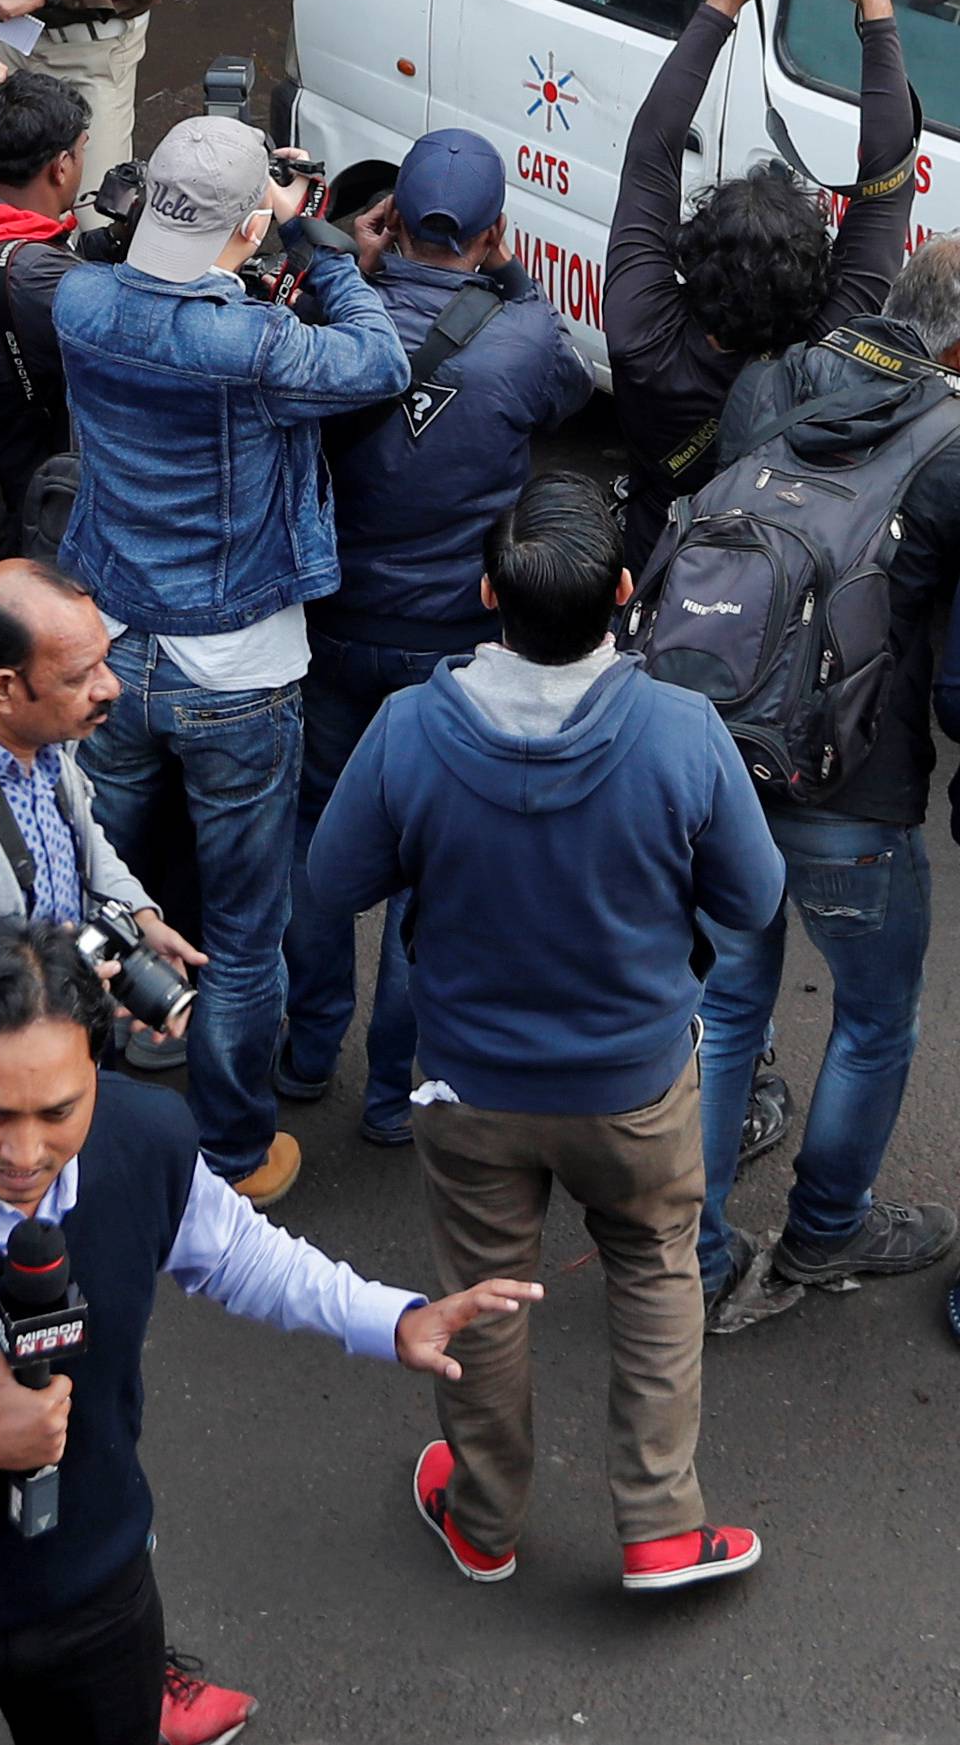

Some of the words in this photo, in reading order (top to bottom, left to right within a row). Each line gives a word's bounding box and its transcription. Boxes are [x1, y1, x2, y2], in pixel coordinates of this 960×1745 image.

[517, 145, 570, 196] CATS
[862, 170, 906, 196] Nikon
[151, 181, 199, 223] Ucla
[514, 228, 606, 334] NATION
[852, 340, 904, 373] Nikon
[667, 444, 698, 472] Nikon
[16, 1319, 84, 1346] MIRROR
[19, 1329, 83, 1357] NOW
